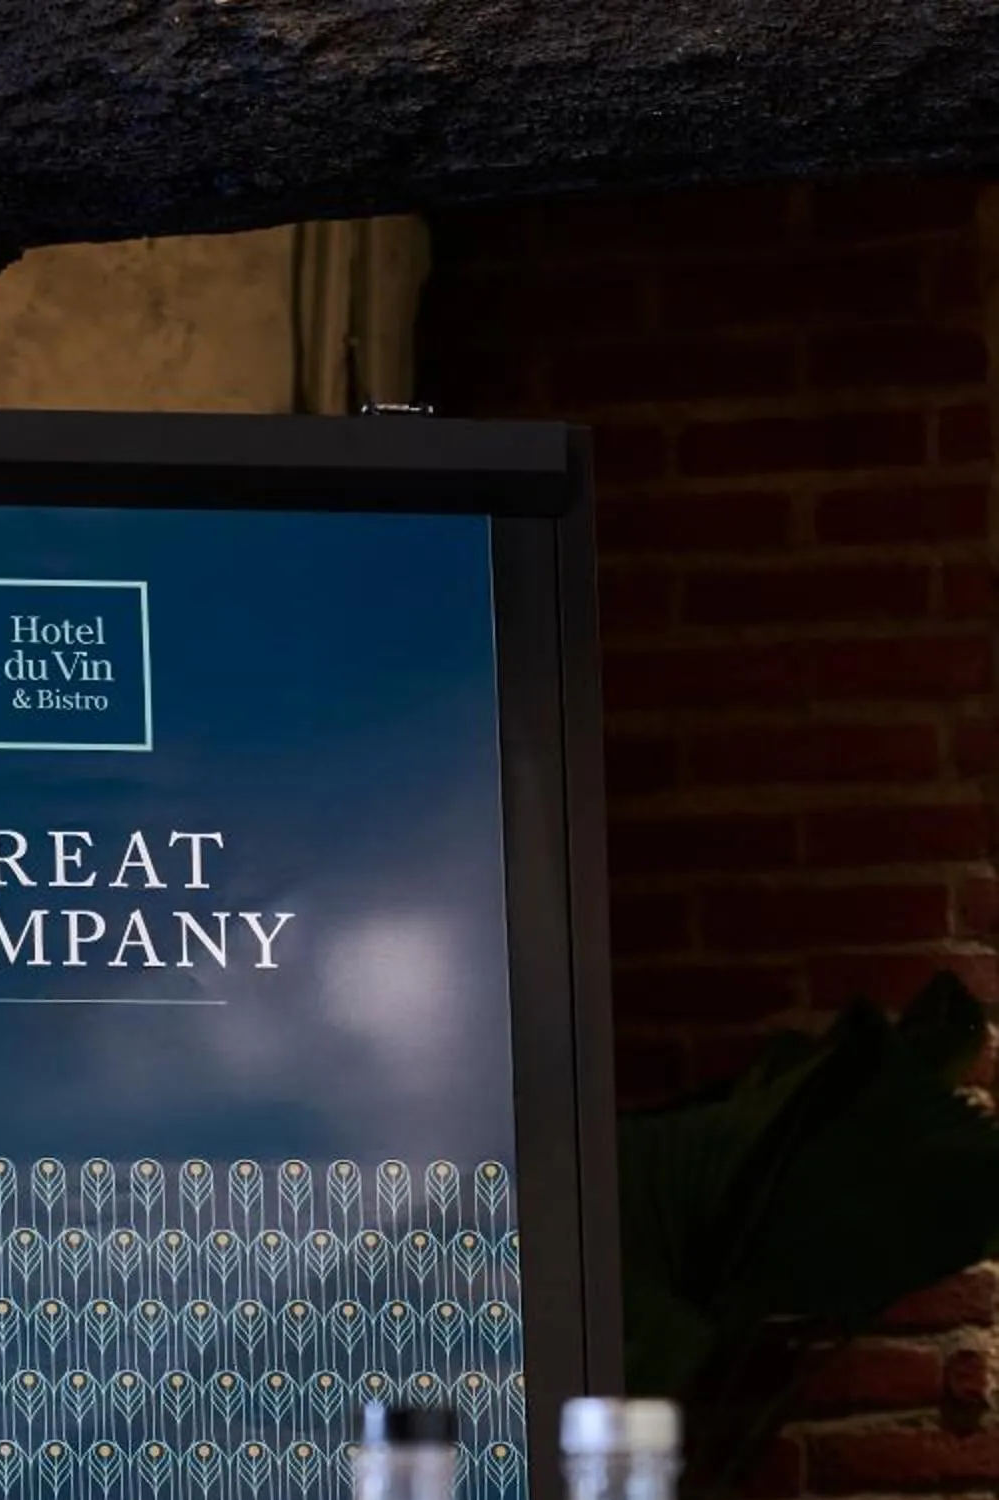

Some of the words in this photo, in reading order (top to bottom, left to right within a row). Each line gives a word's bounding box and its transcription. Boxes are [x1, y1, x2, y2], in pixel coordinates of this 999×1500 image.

[10, 615, 106, 645] Hotel
[4, 649, 49, 681] du
[51, 650, 115, 682] Vin
[12, 688, 32, 709] &
[37, 688, 109, 711] Bistro
